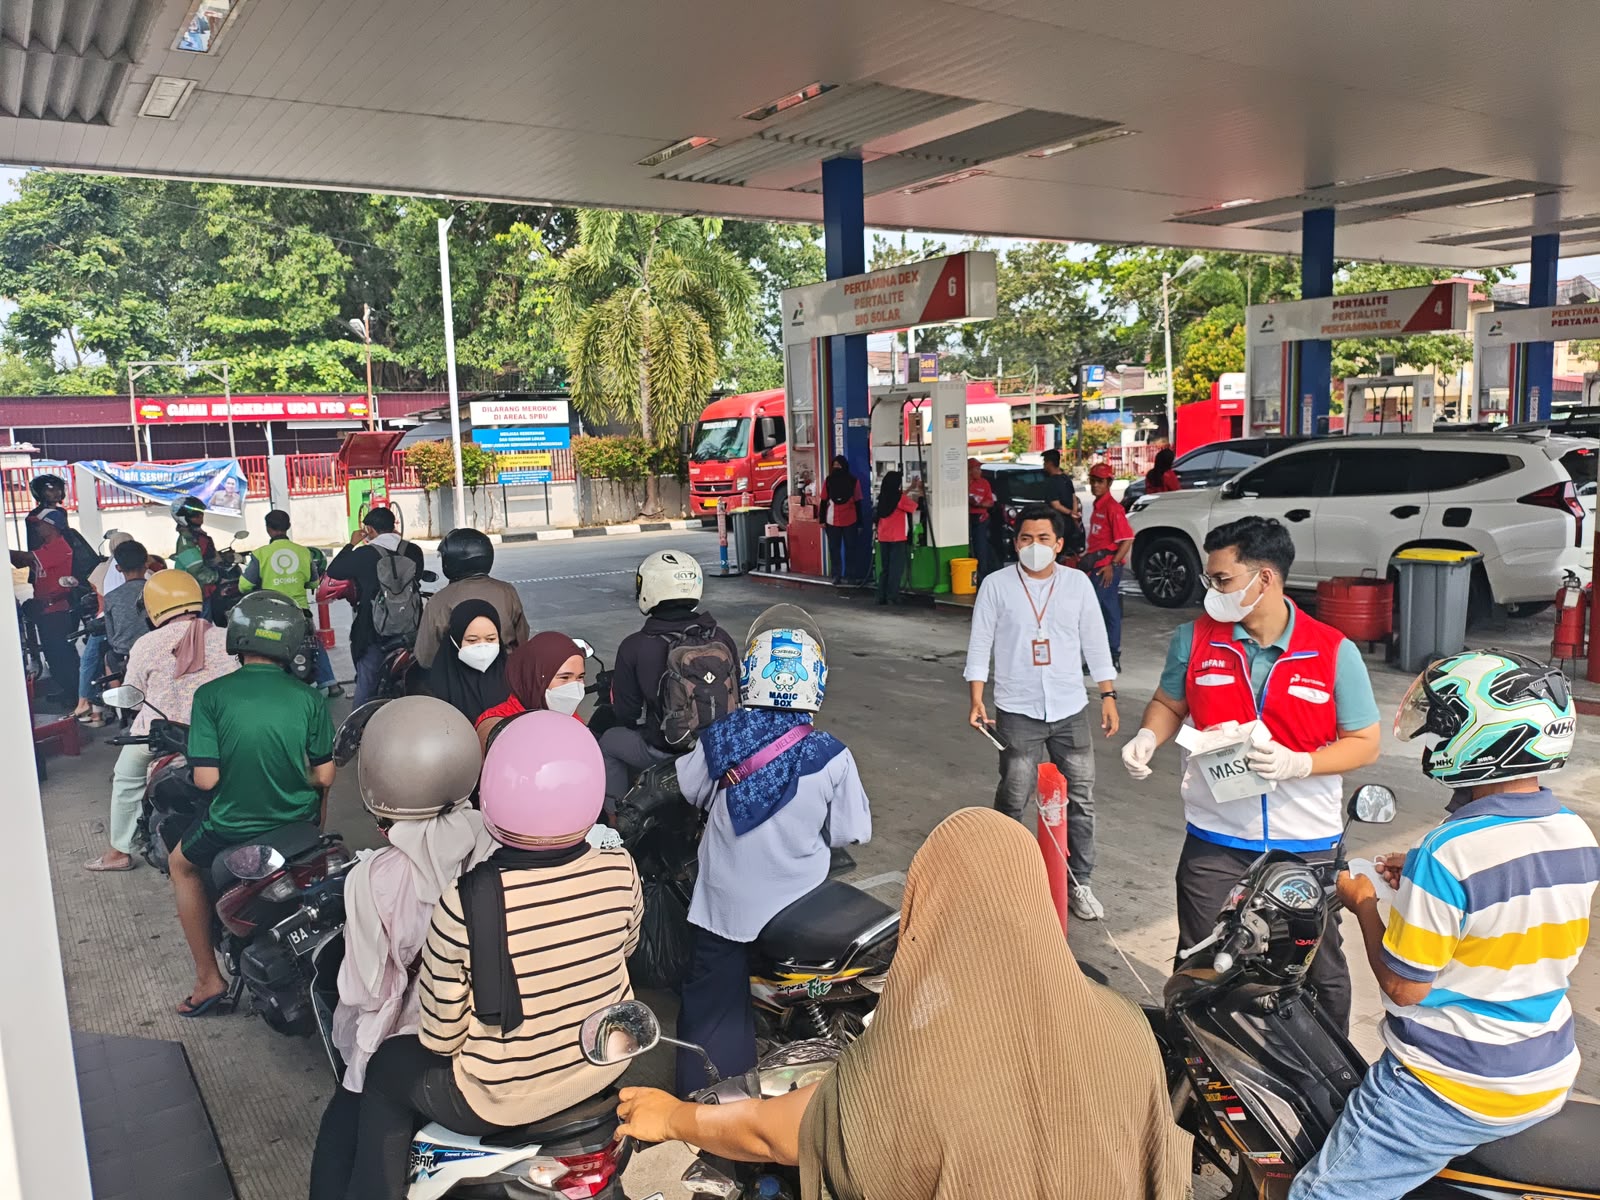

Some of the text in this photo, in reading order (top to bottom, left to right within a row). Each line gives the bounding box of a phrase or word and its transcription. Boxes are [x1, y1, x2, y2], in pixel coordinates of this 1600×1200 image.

[844, 270, 919, 295] PERTAMINA DEX
[948, 276, 957, 297] 6
[854, 291, 904, 309] PERTALITE
[1332, 296, 1388, 310] PERTALITE
[1434, 300, 1443, 315] 4
[856, 309, 900, 326] BIO SOLAR
[1332, 308, 1387, 321] PERTALITE
[1321, 319, 1401, 334] PERTAMINA DEX
[140, 471, 172, 482] SESUAI
[1202, 659, 1226, 669] IRFAN
[769, 691, 798, 700] MAGIC
[774, 699, 792, 707] BOX
[1548, 719, 1576, 736] NHK
[290, 928, 309, 944] BA
